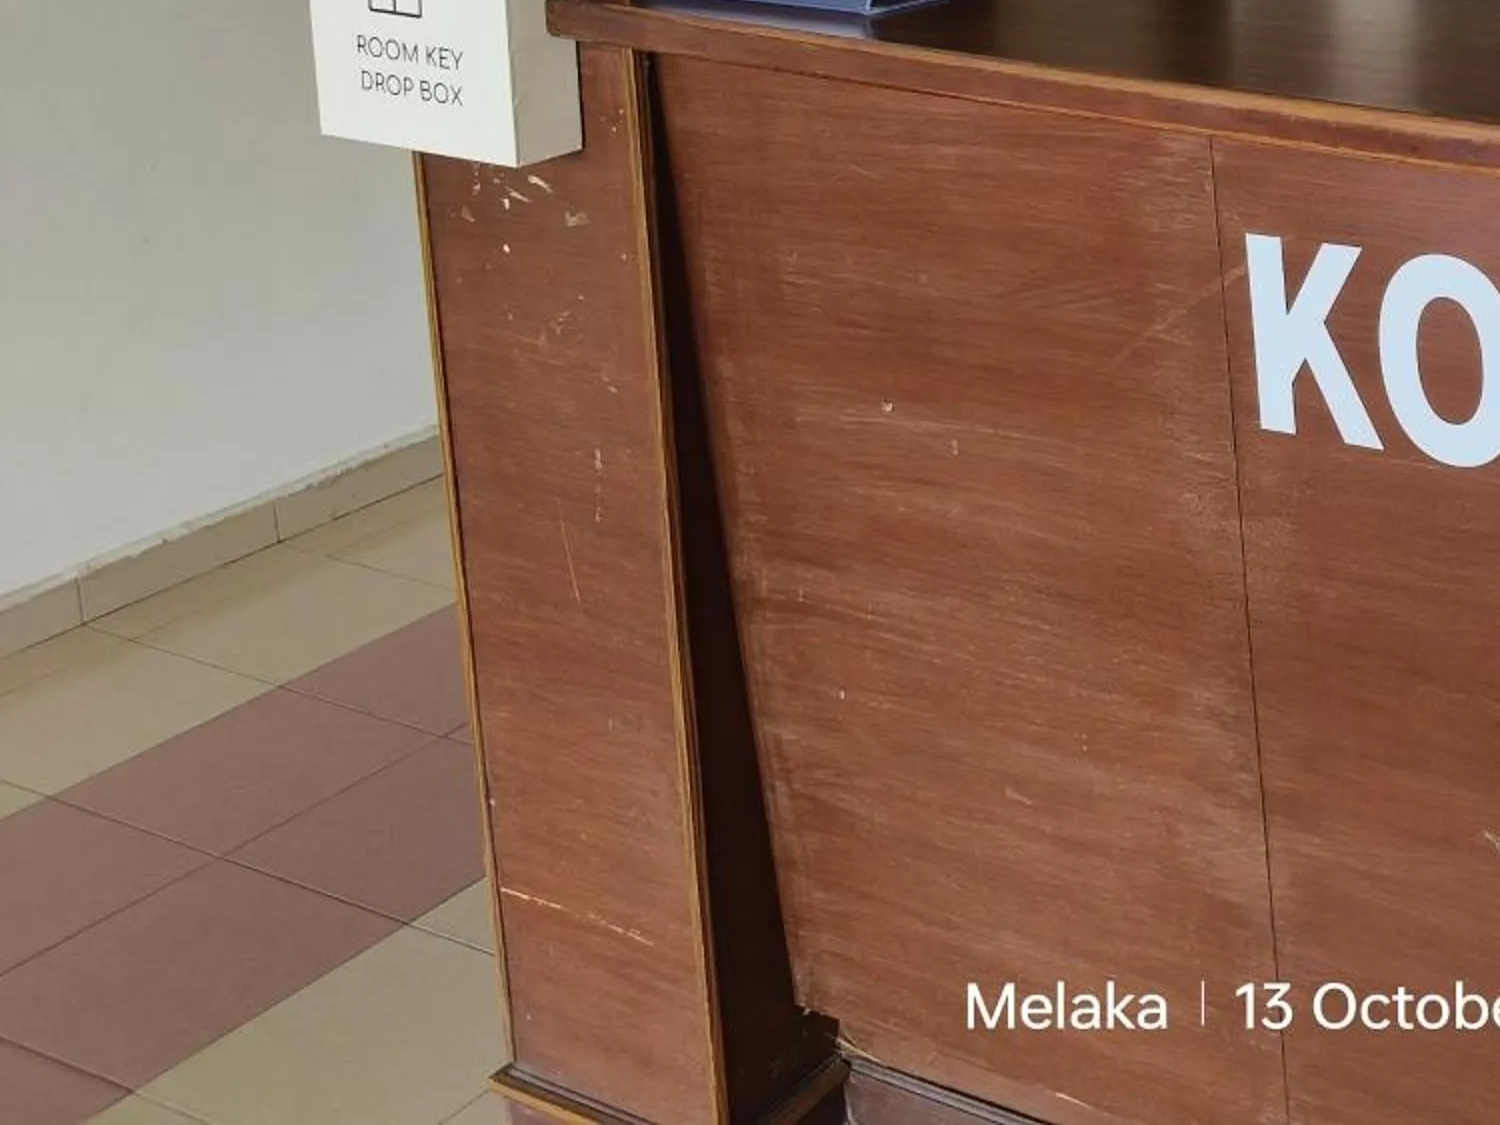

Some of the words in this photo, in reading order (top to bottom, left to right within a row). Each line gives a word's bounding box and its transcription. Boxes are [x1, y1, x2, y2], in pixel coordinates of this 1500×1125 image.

[357, 34, 419, 64] ROOM
[425, 45, 463, 70] KEY
[361, 69, 415, 97] DROP
[420, 80, 463, 106] BOX
